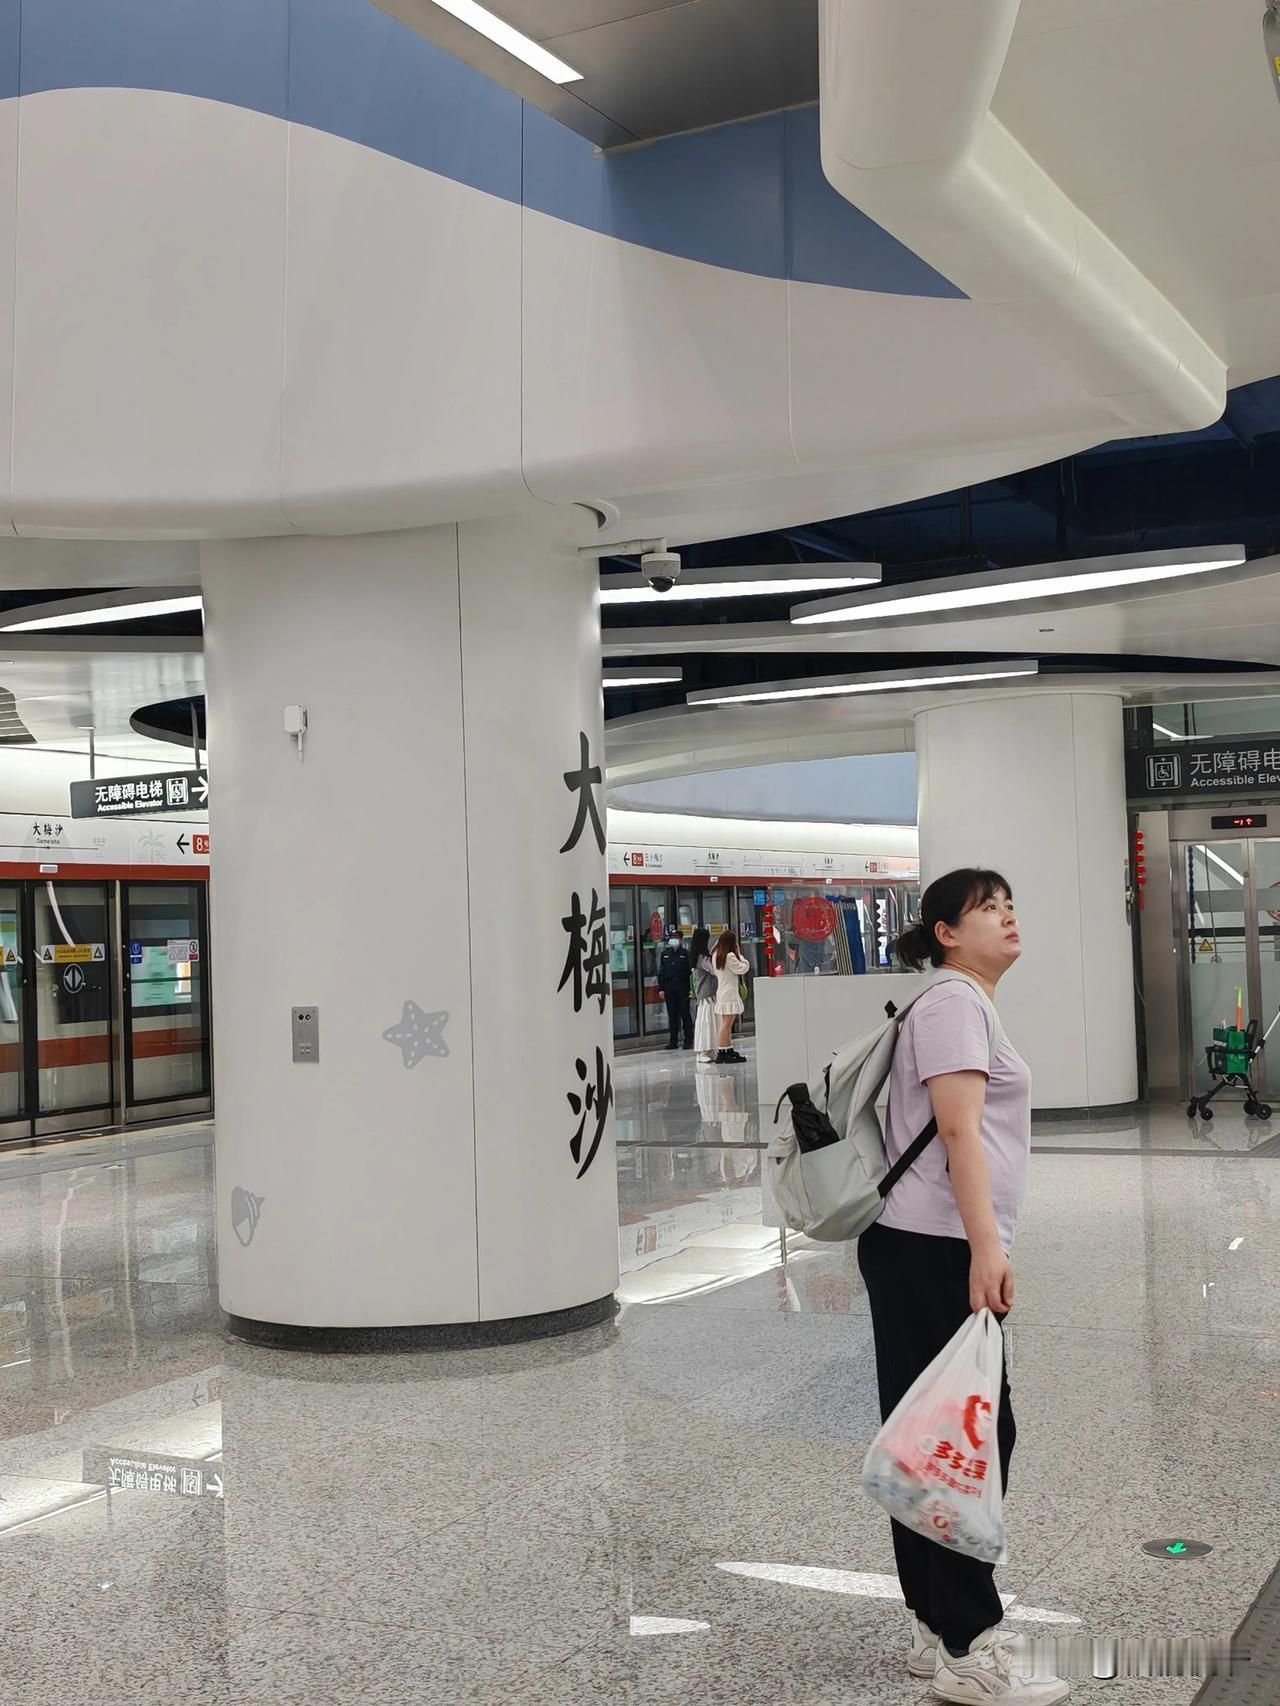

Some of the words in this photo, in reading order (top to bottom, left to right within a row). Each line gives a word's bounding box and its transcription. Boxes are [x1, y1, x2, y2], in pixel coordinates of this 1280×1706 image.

[1190, 774, 1255, 787] Accessible
[95, 780, 163, 803] 无障碍电梯
[97, 800, 134, 812] Accessible
[135, 799, 163, 809] Elevator
[33, 822, 63, 836] 大梅沙
[558, 731, 613, 1180] 大梅沙
